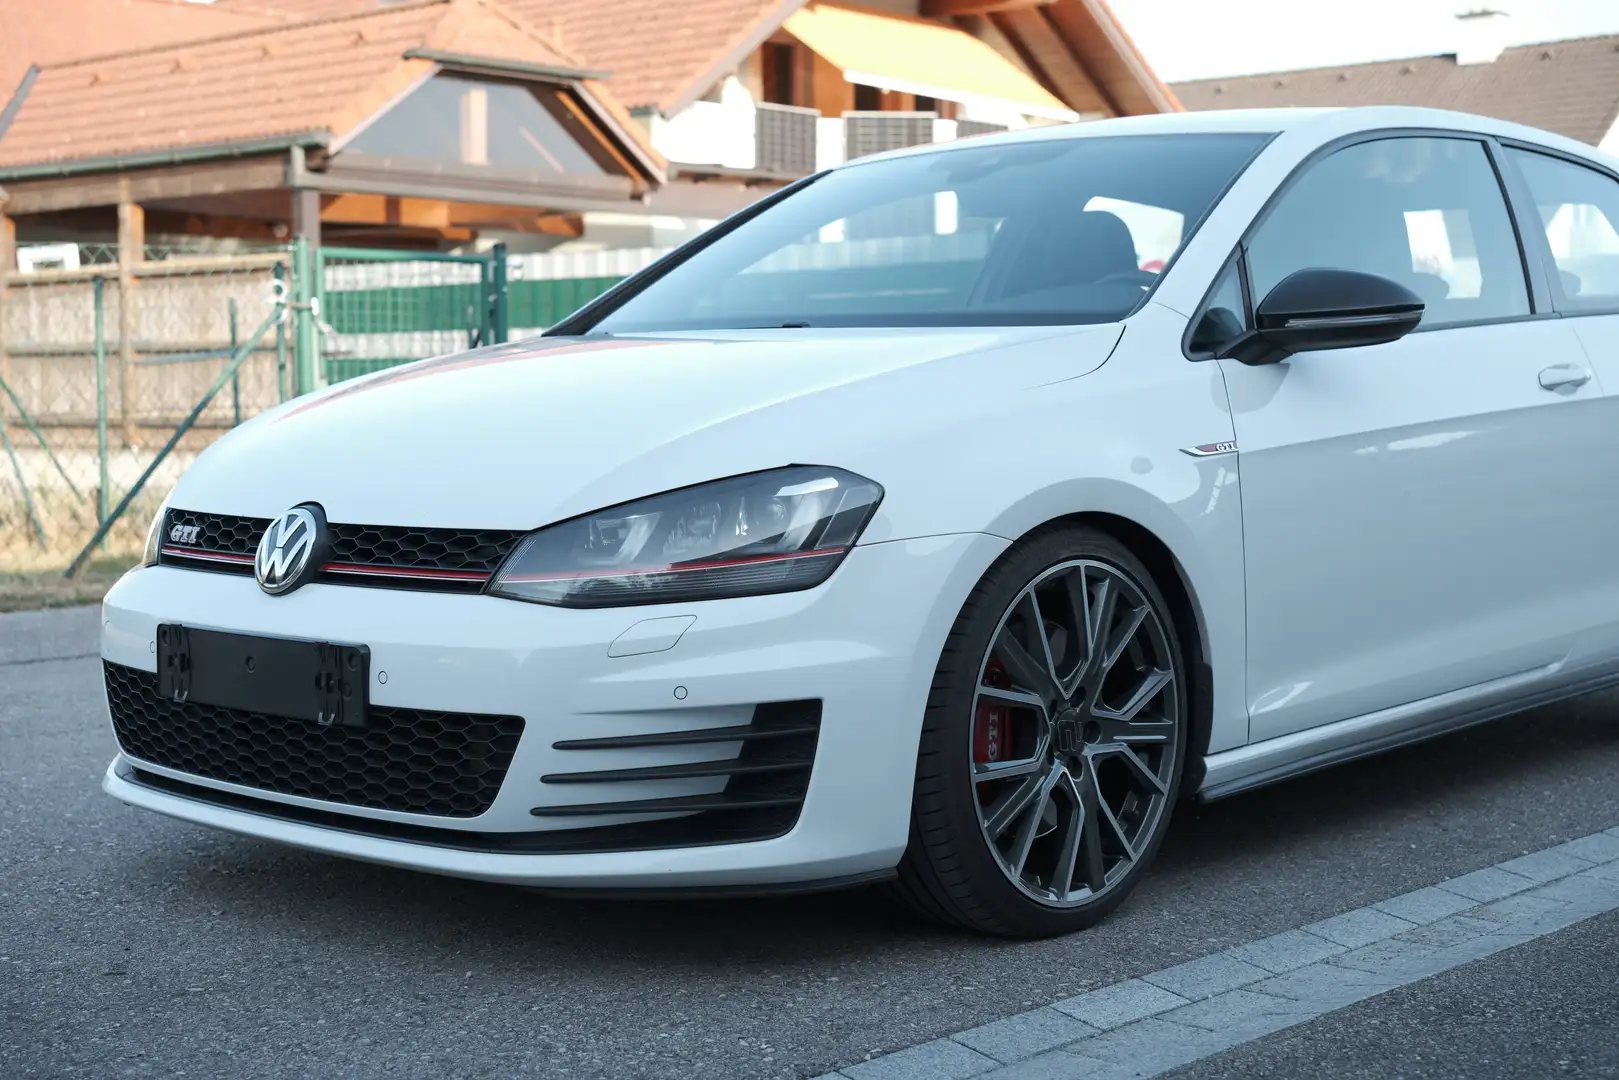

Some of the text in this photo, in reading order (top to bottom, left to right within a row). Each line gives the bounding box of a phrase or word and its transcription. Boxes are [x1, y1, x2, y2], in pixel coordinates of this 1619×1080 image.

[1216, 442, 1235, 452] GTI
[170, 524, 200, 543] GTI
[988, 711, 999, 761] GTI
